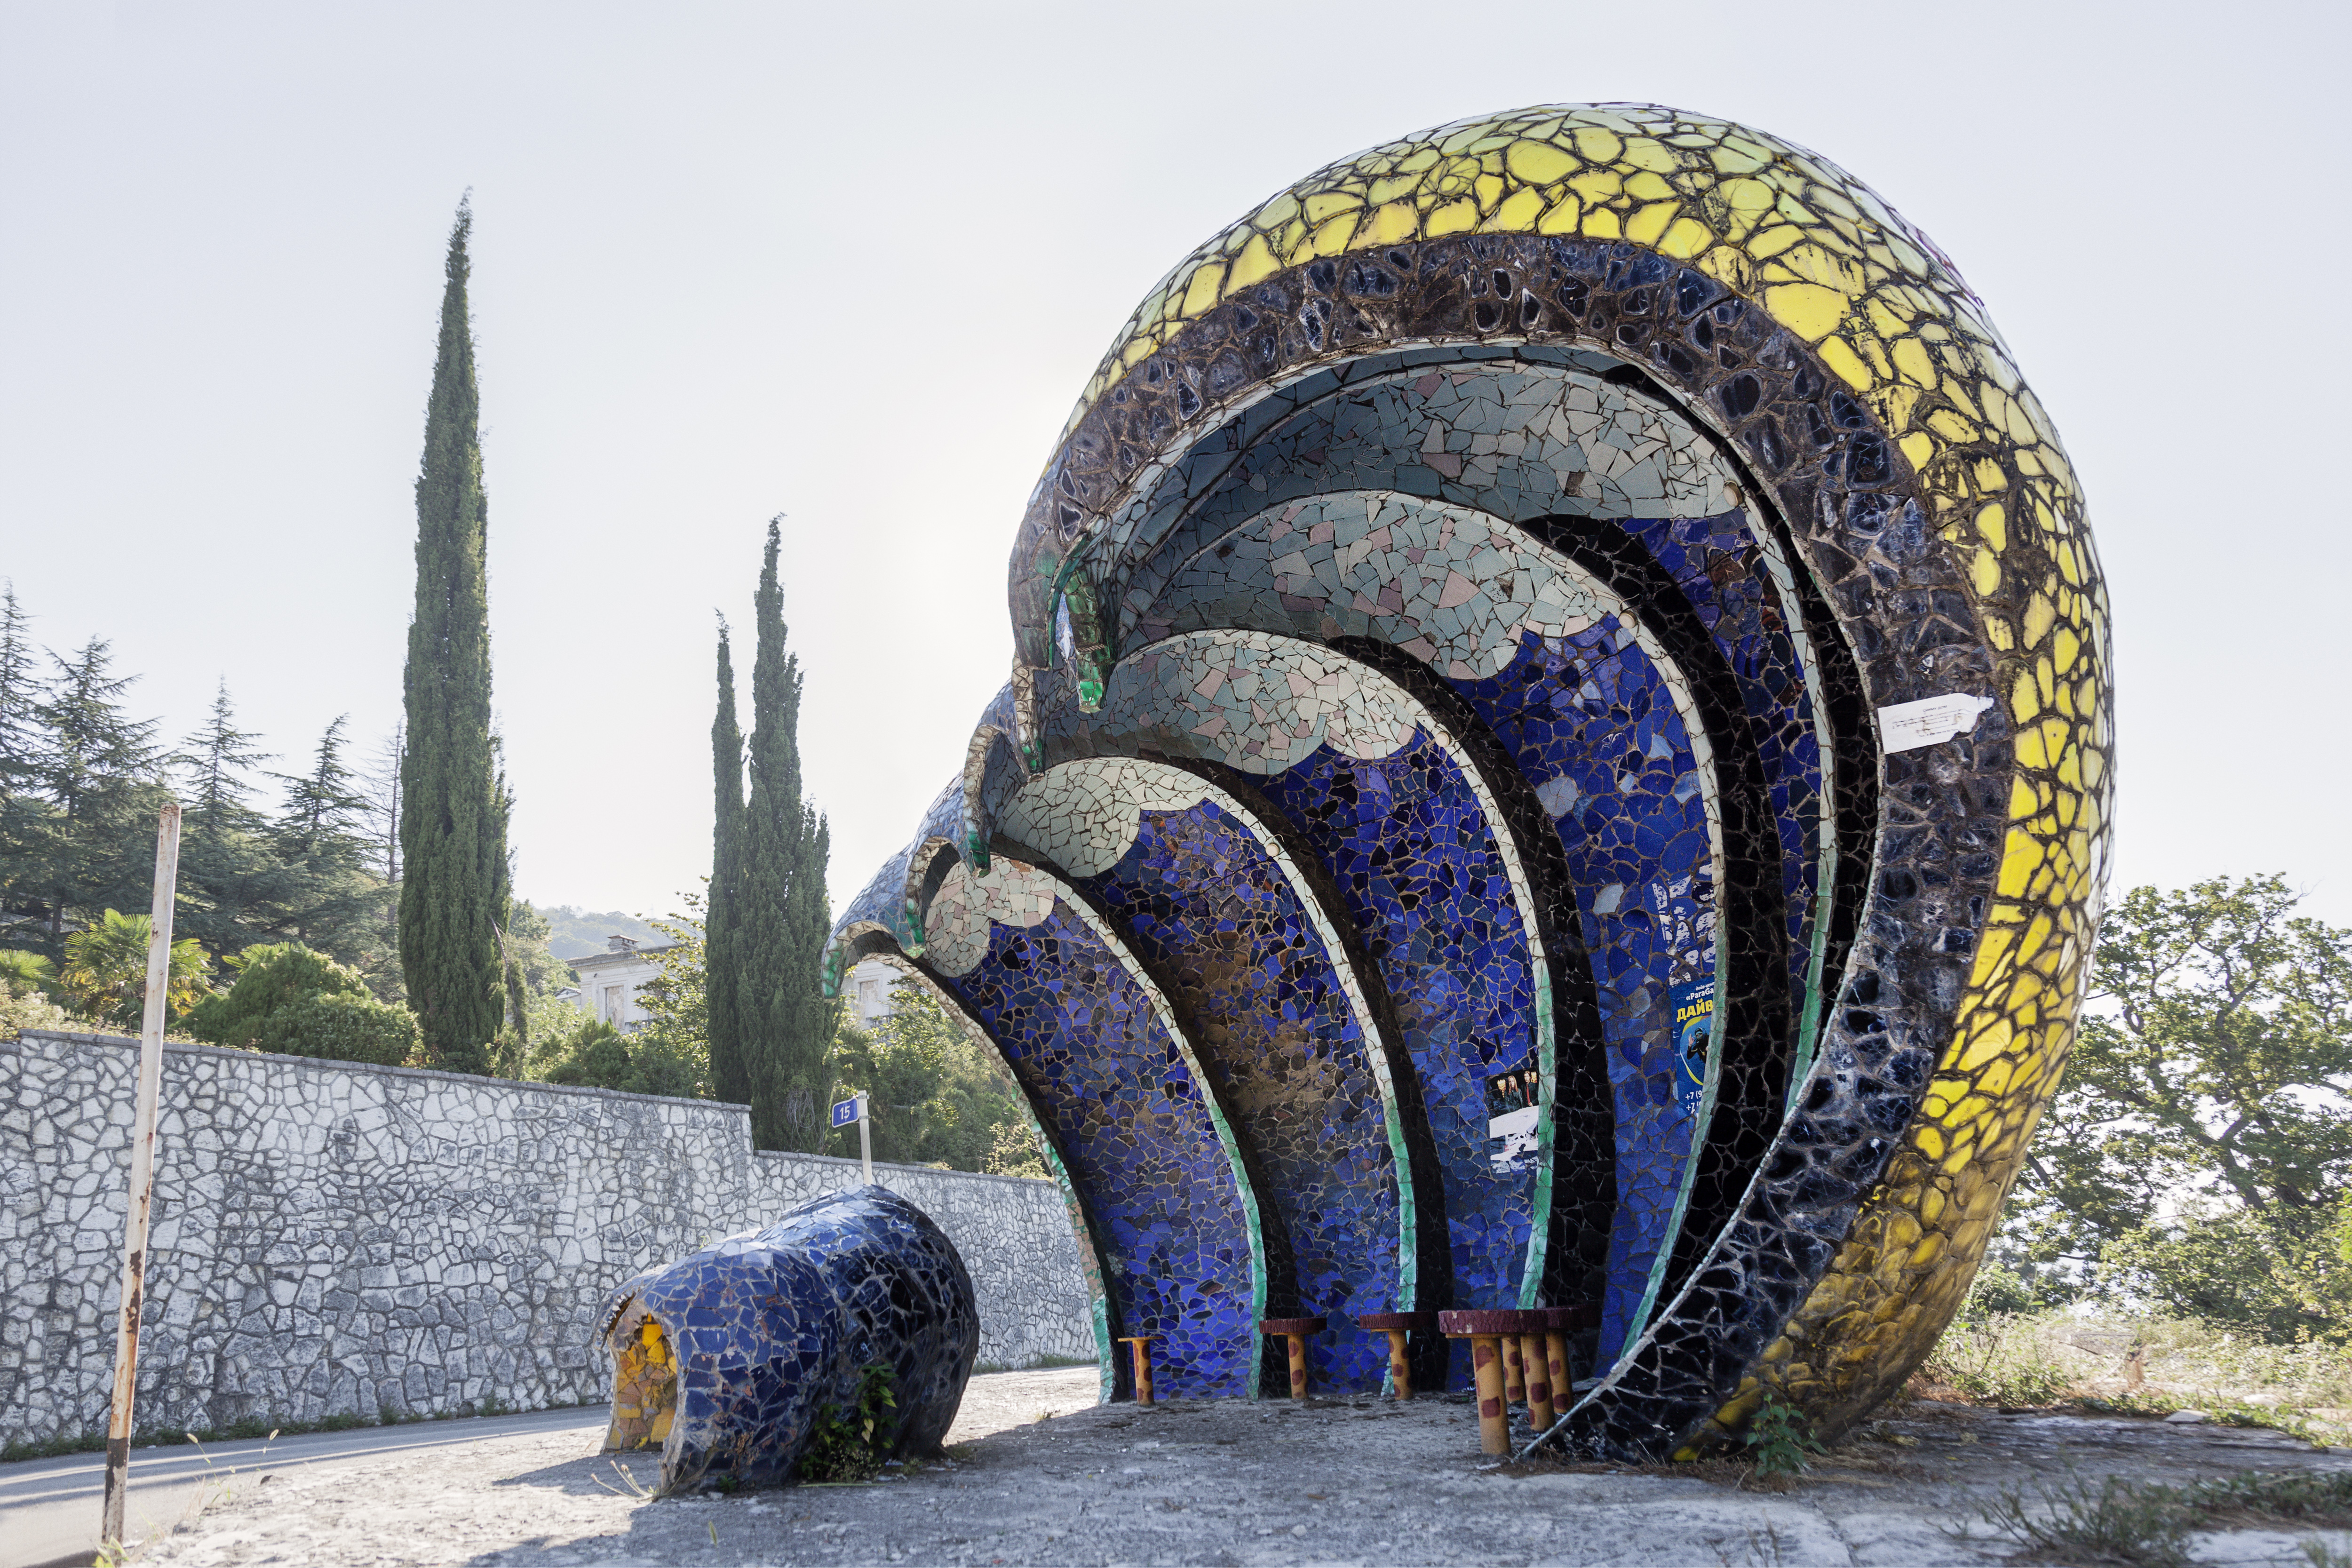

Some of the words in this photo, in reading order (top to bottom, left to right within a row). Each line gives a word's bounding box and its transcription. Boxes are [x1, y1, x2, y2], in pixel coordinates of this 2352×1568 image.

[1677, 998, 1713, 1023] ДАЙВ
[1685, 1091, 1694, 1100] +7
[1696, 1090, 1702, 1099] (9
[840, 1105, 850, 1120] 15
